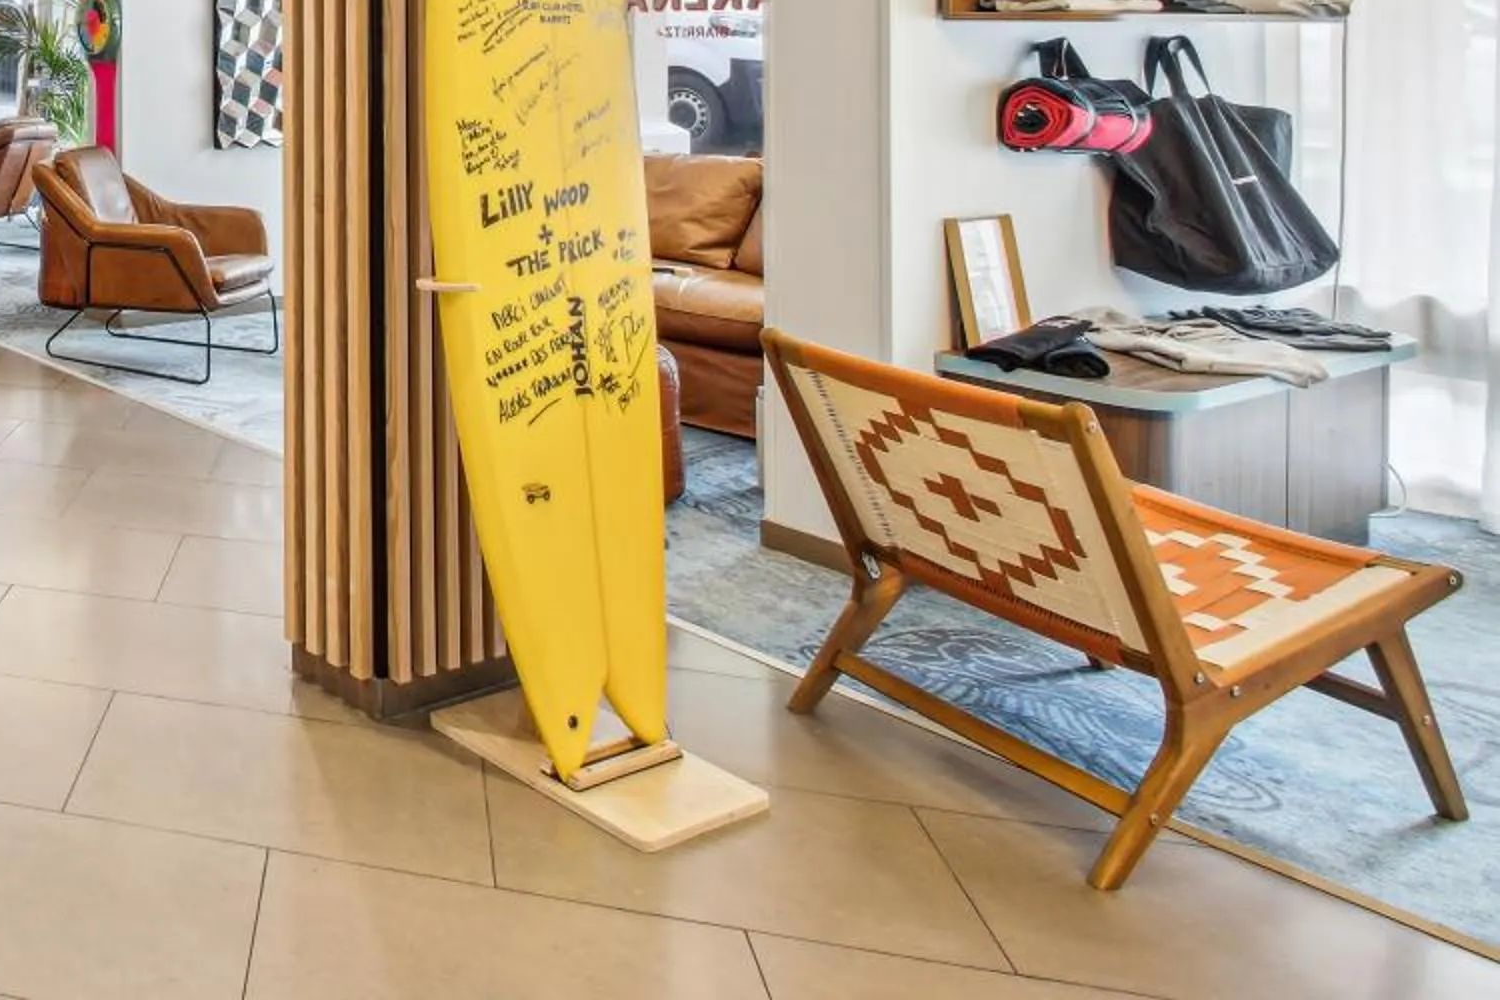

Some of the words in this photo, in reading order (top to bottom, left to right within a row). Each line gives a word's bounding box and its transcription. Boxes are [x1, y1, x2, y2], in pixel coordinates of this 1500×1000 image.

[543, 182, 590, 217] WOOD
[505, 248, 552, 277] THE
[565, 296, 594, 397] JOHAN
